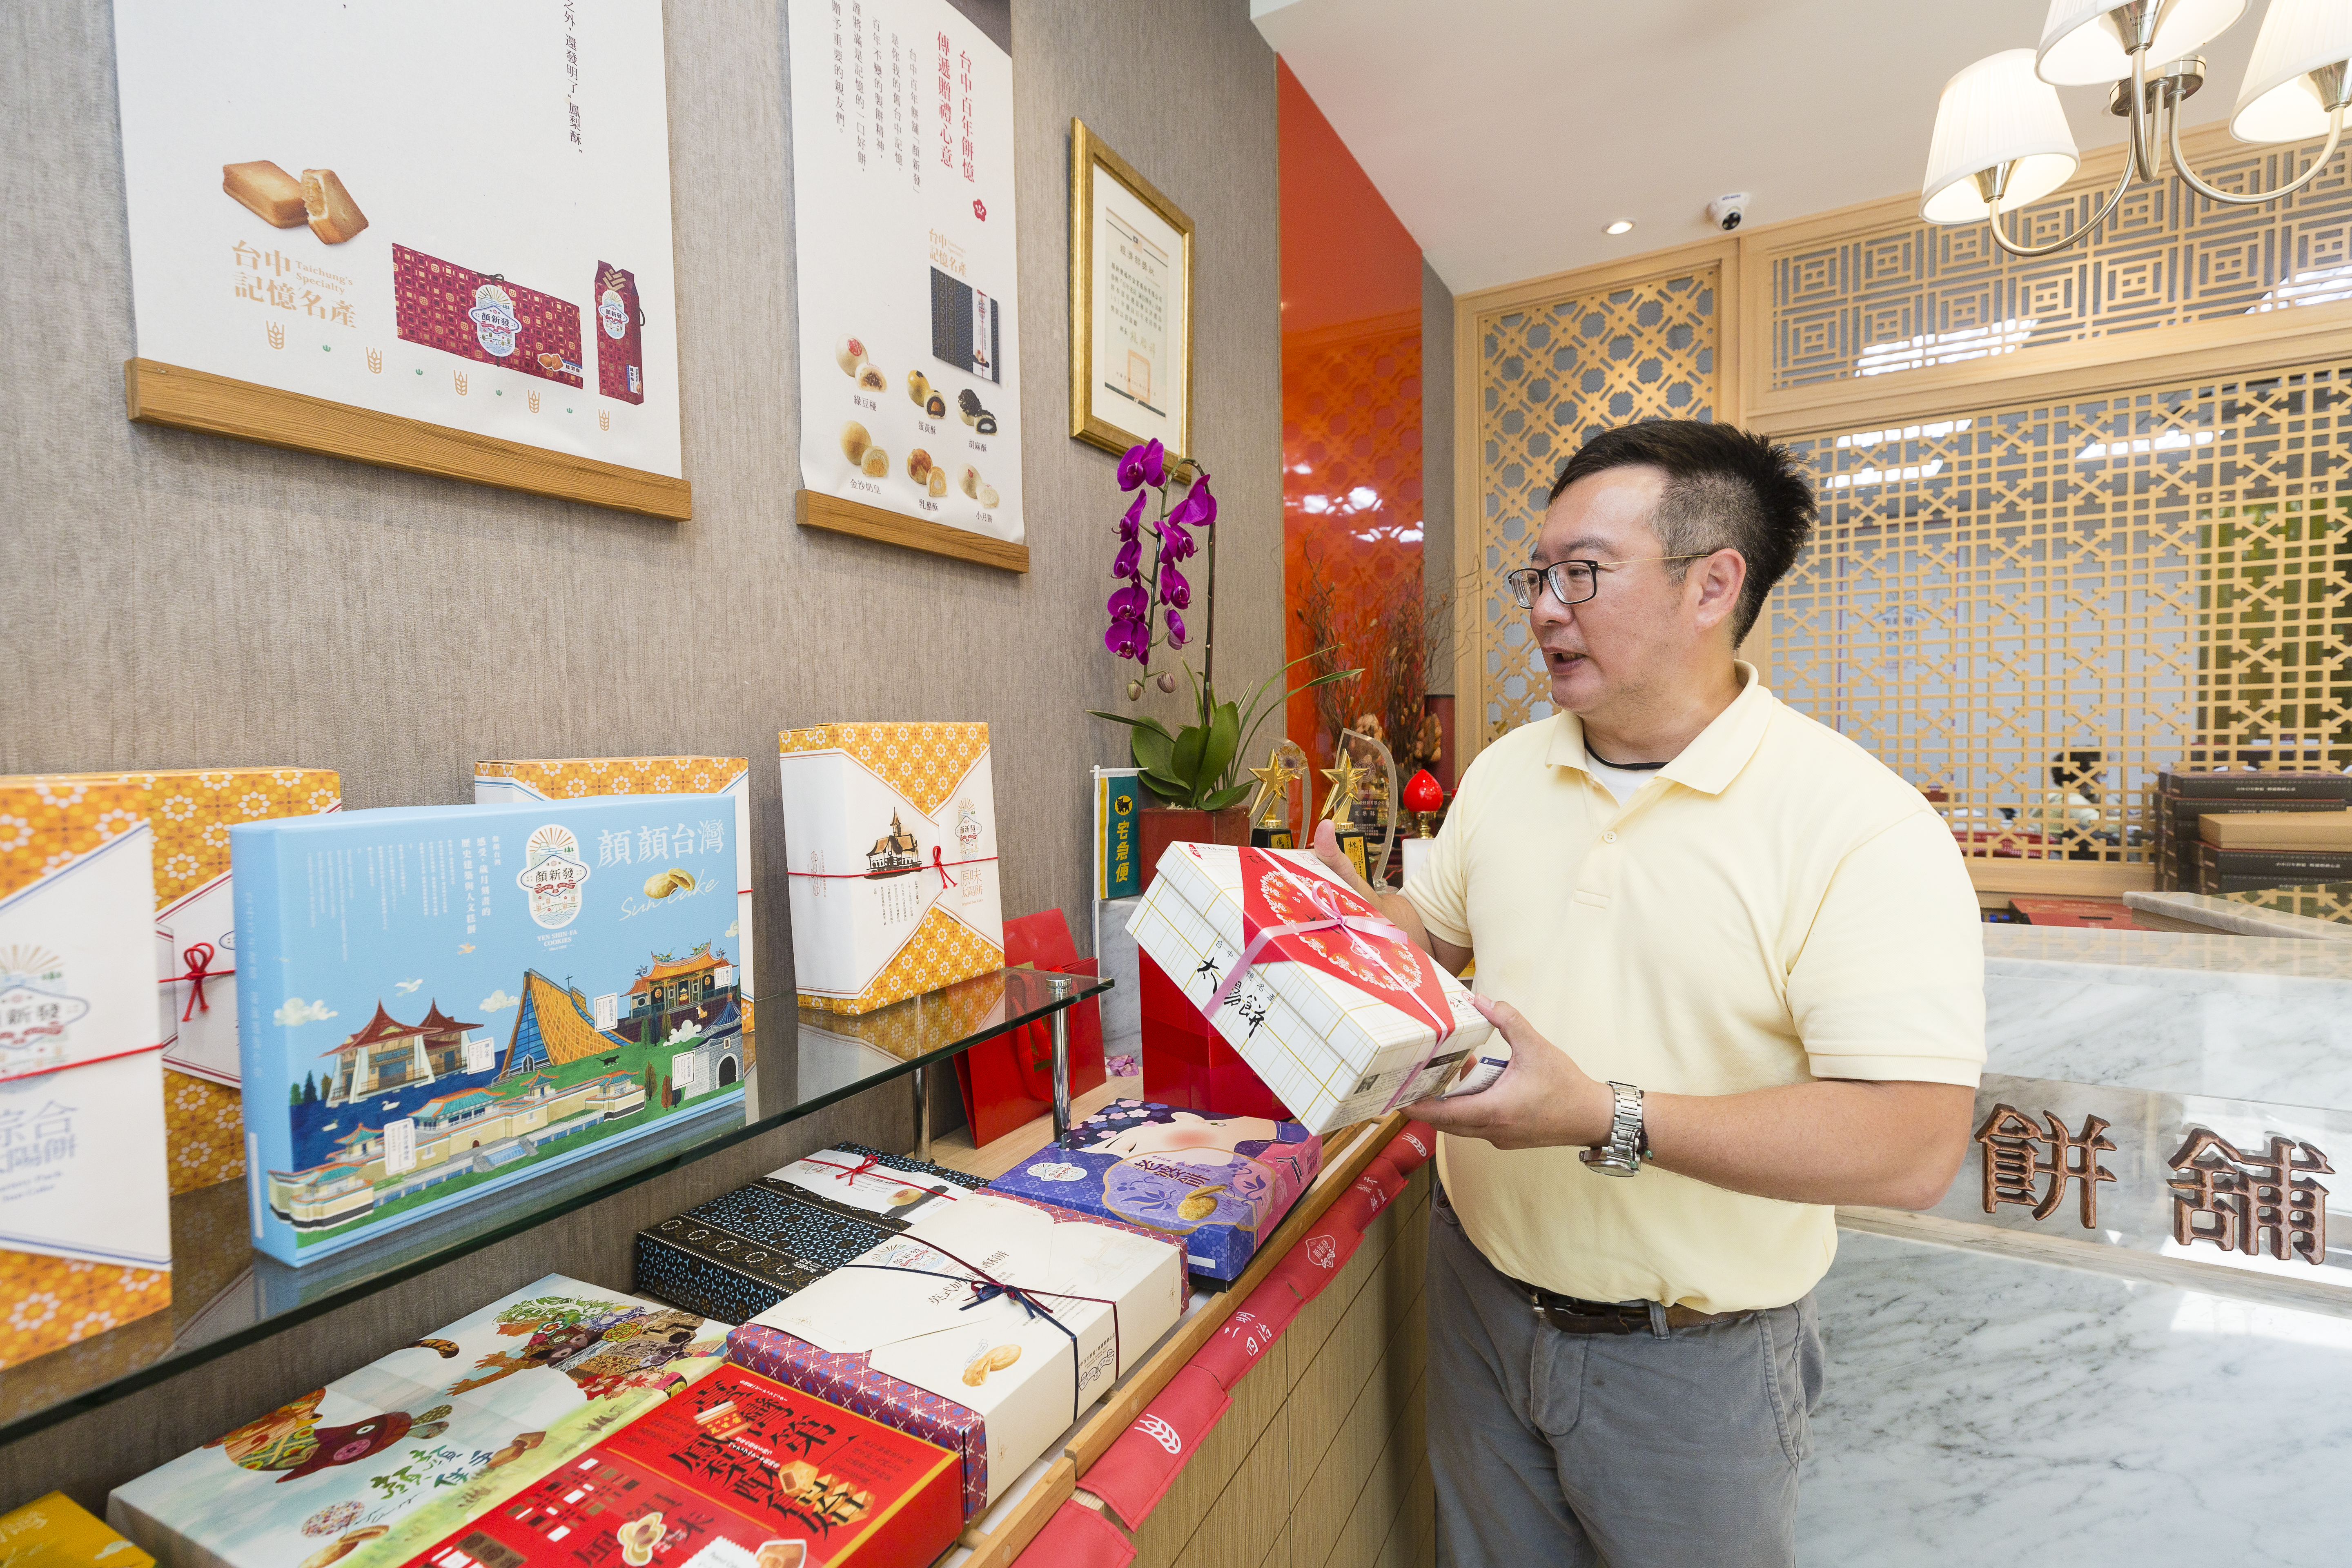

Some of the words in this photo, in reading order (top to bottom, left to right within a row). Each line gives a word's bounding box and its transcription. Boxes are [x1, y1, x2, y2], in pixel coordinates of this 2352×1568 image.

[938, 30, 953, 169] 傳遞贈禮心意
[960, 50, 975, 183] 台中百年餅憶
[929, 228, 947, 248] 台中
[232, 240, 290, 276] 台中
[929, 245, 967, 278] 記憶名產
[295, 261, 353, 285] Taichung's
[296, 272, 345, 295] Specialty
[233, 271, 356, 328] 記憶名產
[481, 312, 509, 327] 顏新發
[918, 421, 936, 435] 蛋黃酥
[969, 439, 987, 453] 胡麻酥
[850, 479, 881, 495] 金沙奶皇
[919, 499, 939, 512] 乳酪酥
[960, 825, 976, 834] 顏新發
[596, 819, 724, 869] 顏顏台灣
[1116, 820, 1129, 883] 宅急便
[536, 868, 574, 883] 顏新發
[961, 867, 982, 887] 原味
[961, 884, 983, 898] 太陽餅
[619, 896, 662, 922] Sun
[537, 933, 550, 941] YEN
[544, 937, 571, 947] COOKIES
[0, 1003, 61, 1025] 新發
[0, 1134, 76, 1173] 陽餅
[1134, 1159, 1211, 1187] 老婆餅
[1974, 1103, 2336, 1265] 餅舖
[893, 1248, 922, 1265] 顏新發
[1313, 1239, 1330, 1259] 顏新發
[1236, 1312, 1272, 1343] 明治
